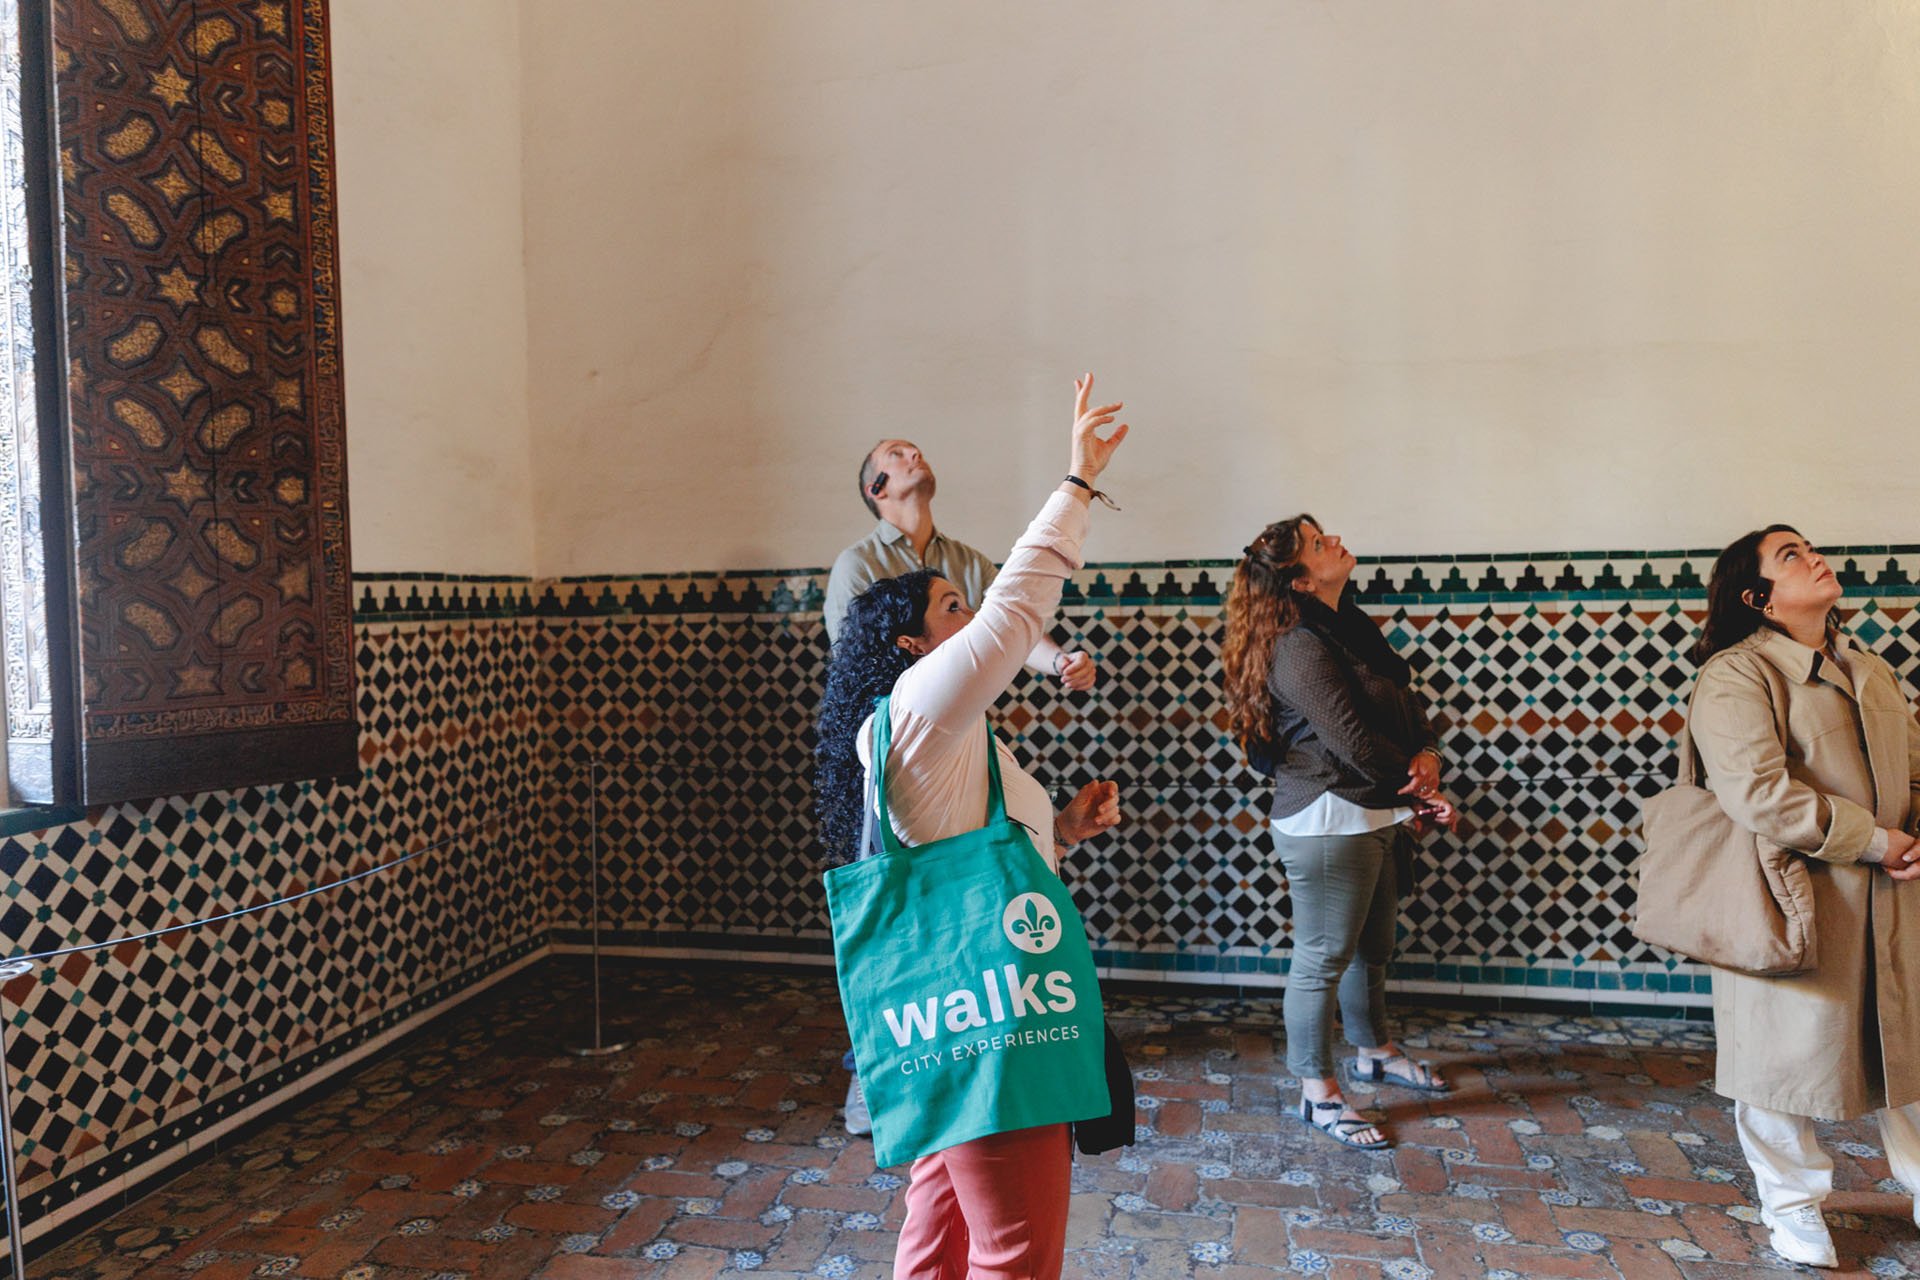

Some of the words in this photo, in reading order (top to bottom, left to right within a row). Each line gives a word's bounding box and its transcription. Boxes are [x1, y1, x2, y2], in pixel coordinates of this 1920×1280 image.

[883, 964, 1076, 1048] walks
[902, 1053, 943, 1075] CITY
[953, 1026, 1079, 1061] EXPERIENCES
